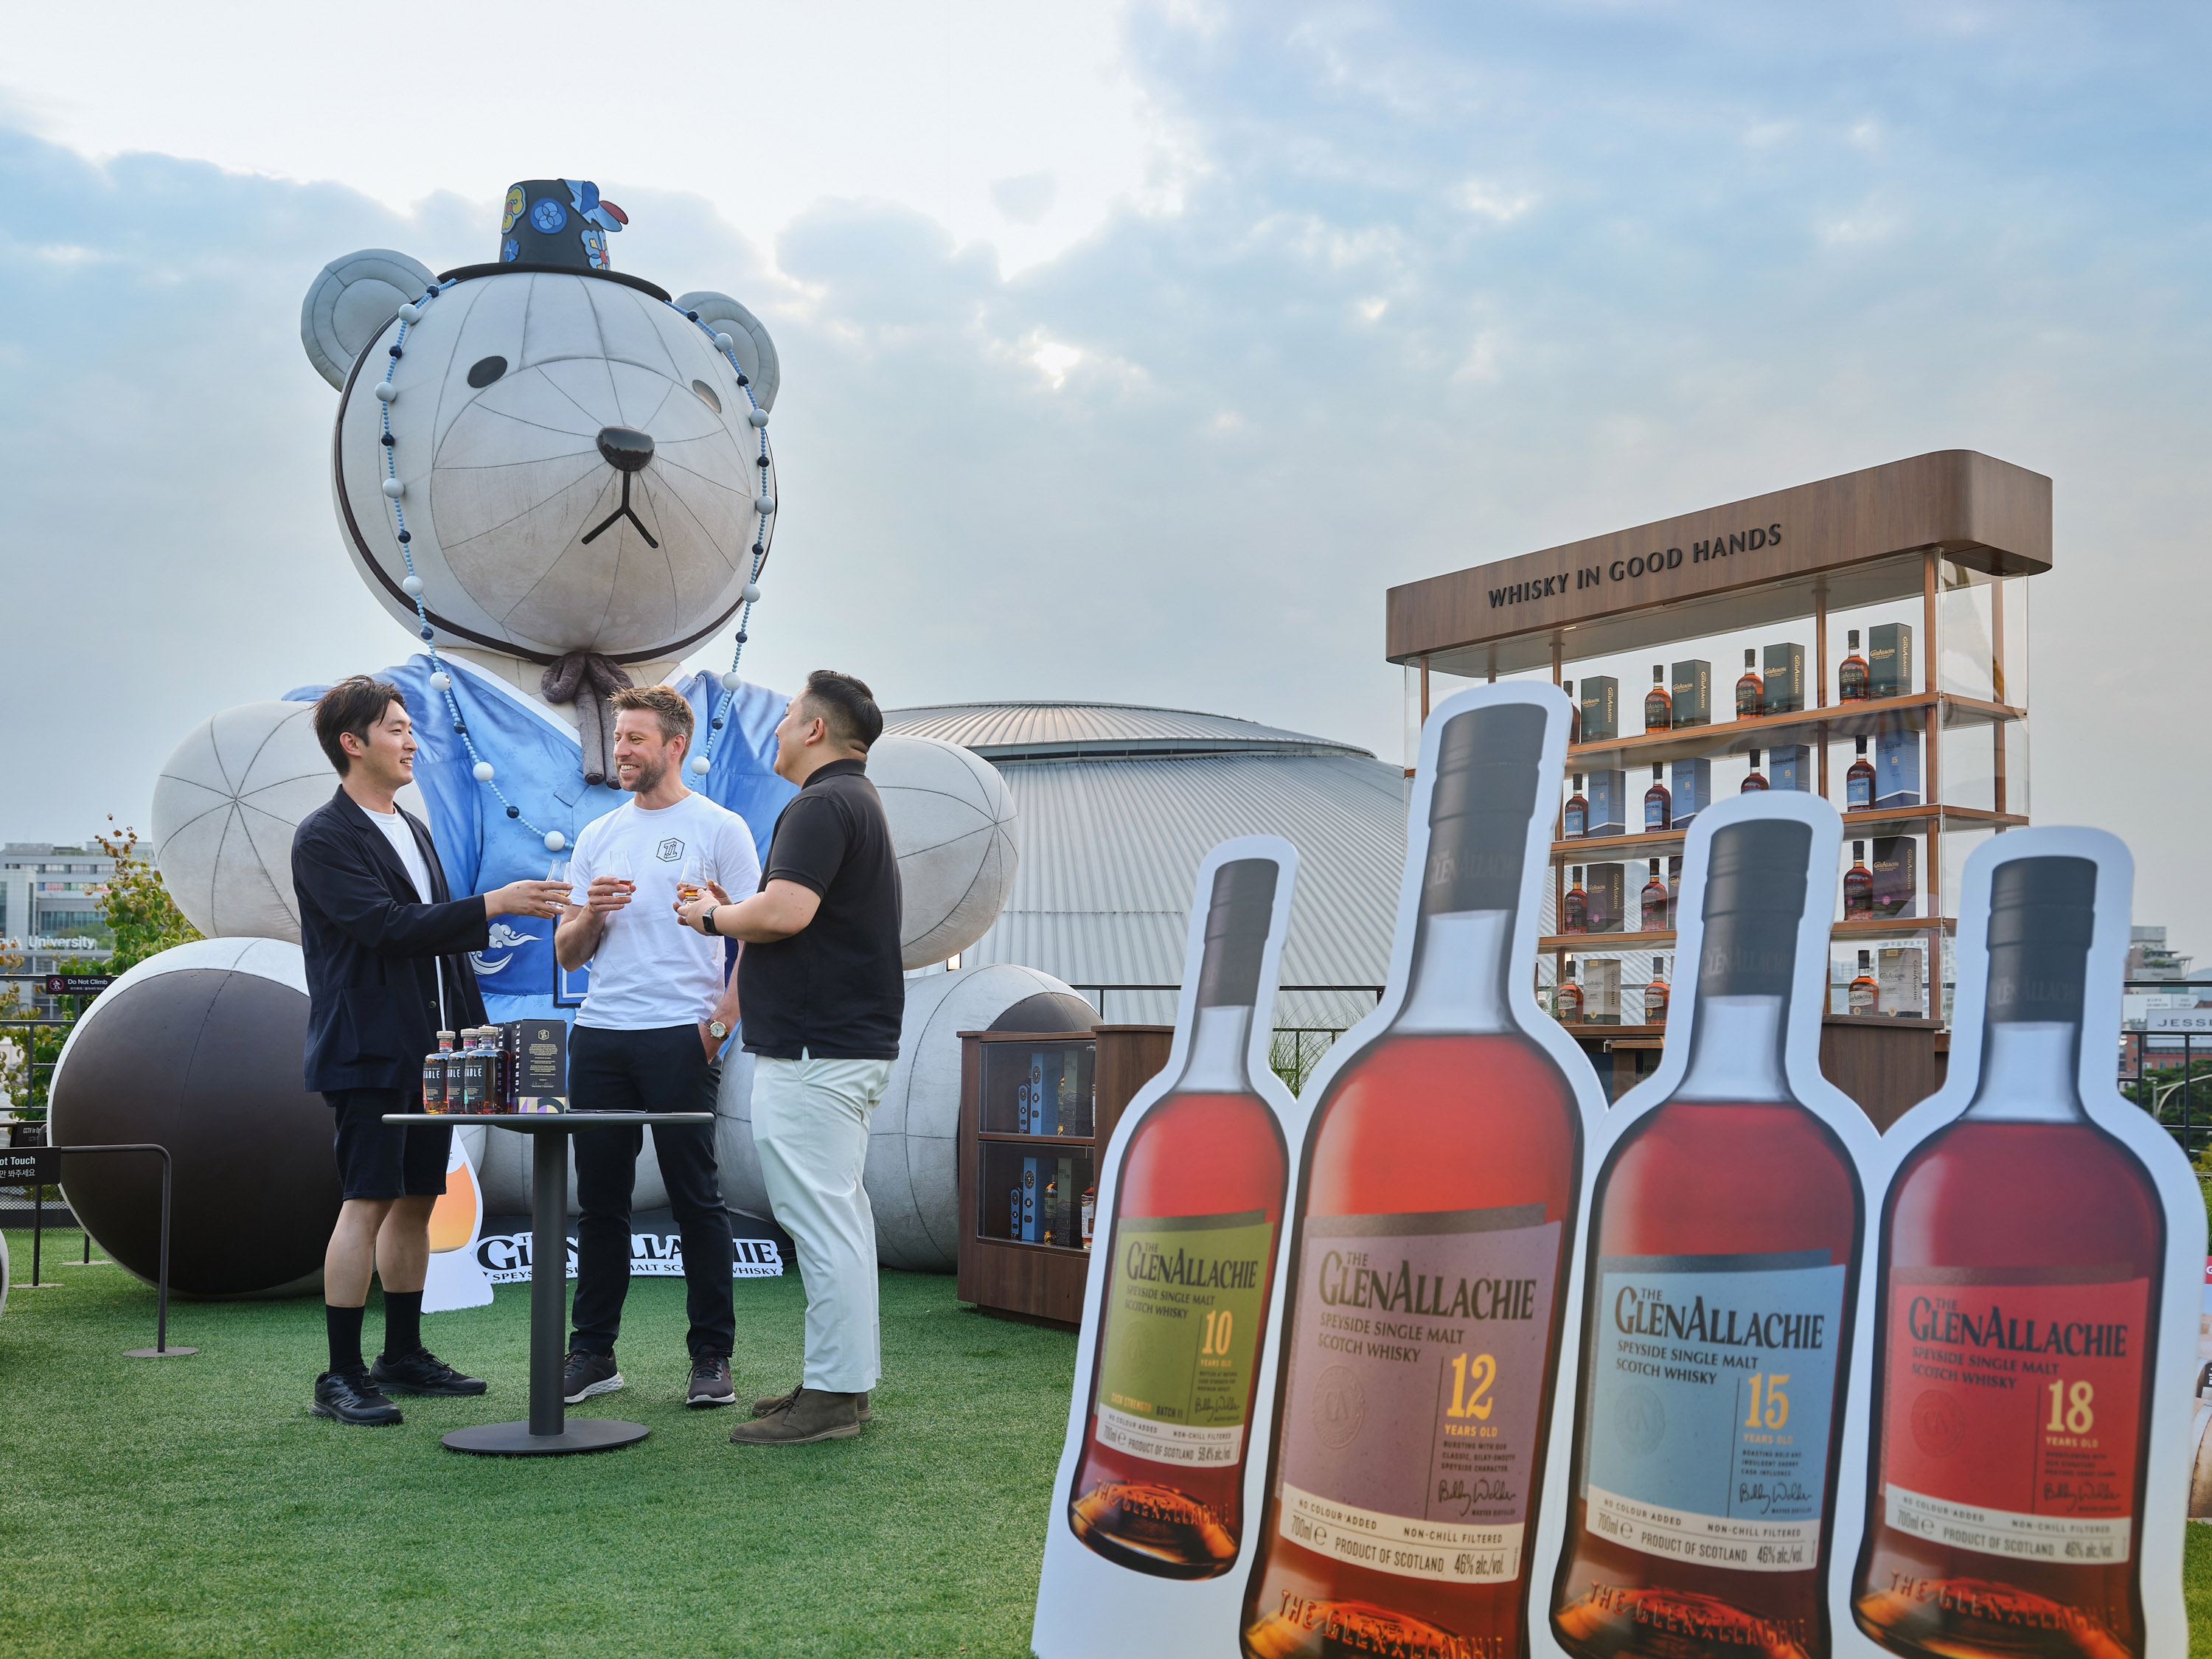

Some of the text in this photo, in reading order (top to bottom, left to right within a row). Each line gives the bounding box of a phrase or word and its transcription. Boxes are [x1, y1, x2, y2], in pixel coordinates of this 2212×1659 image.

[1488, 523, 1781, 608] WHISKY IN GOOD HANDS
[28, 935, 96, 950] University
[0, 1156, 35, 1166] ot Touch
[8, 1169, 35, 1178] 봐주세요
[1126, 1241, 1258, 1289] GLENALLACHIE
[1346, 1251, 1368, 1267] THE
[1318, 1250, 1537, 1321] GLENALLACHIE
[1641, 1288, 1663, 1301] THE
[1615, 1286, 1824, 1349] GLENALLACHIE
[1935, 1297, 1958, 1311] THE
[1202, 1310, 1233, 1355] 10
[1320, 1311, 1465, 1345] SPEYSIDE SINGLE MALT
[1909, 1295, 2128, 1357] GLENALLACHIE
[1318, 1332, 1422, 1363] SCOTCH WHISKY
[1618, 1340, 1759, 1369] SPEYSIDE SINGLE MALT
[1912, 1346, 2059, 1375] SPEYSIDE SINGLE MALT
[1447, 1352, 1497, 1420] 12
[1616, 1358, 1717, 1385] SCOTCH WHISKY
[1912, 1363, 2017, 1390] SCOTCH WHISKY
[1156, 1405, 1176, 1417] BATCH
[1745, 1372, 1790, 1430] 15
[2046, 1379, 2094, 1434] 18
[1444, 1424, 1498, 1438] YEARS OLD
[1743, 1433, 1793, 1445] YEARS OLD
[2046, 1436, 2078, 1447] YEARS
[1299, 1499, 1377, 1530] NO COLOUR ADDED
[1604, 1498, 1681, 1526] NO COLOUR ADDED
[1916, 1500, 1949, 1515] COLOUR
[1953, 1510, 1985, 1522] ADDED
[1404, 1527, 1503, 1544] NON-CHILL FILTERED
[1598, 1512, 1618, 1535] 700ml
[1641, 1531, 1682, 1552] PRODUCT
[1685, 1542, 1697, 1555] OF
[1699, 1544, 1747, 1562] SCOTLAND
[1757, 1545, 1776, 1564] 46%
[1708, 1523, 1801, 1537] NON-CHILL FILTERED
[1943, 1527, 1986, 1547] PRODUCT
[1989, 1537, 2000, 1549] OF
[2004, 1539, 2055, 1557] SCOTLAND
[1291, 1515, 1313, 1542] 700ml
[1335, 1537, 1377, 1561] PRODUCT
[1380, 1548, 1392, 1564] OF
[1394, 1551, 1444, 1573] SCOTLAND
[1454, 1554, 1475, 1575] 46%
